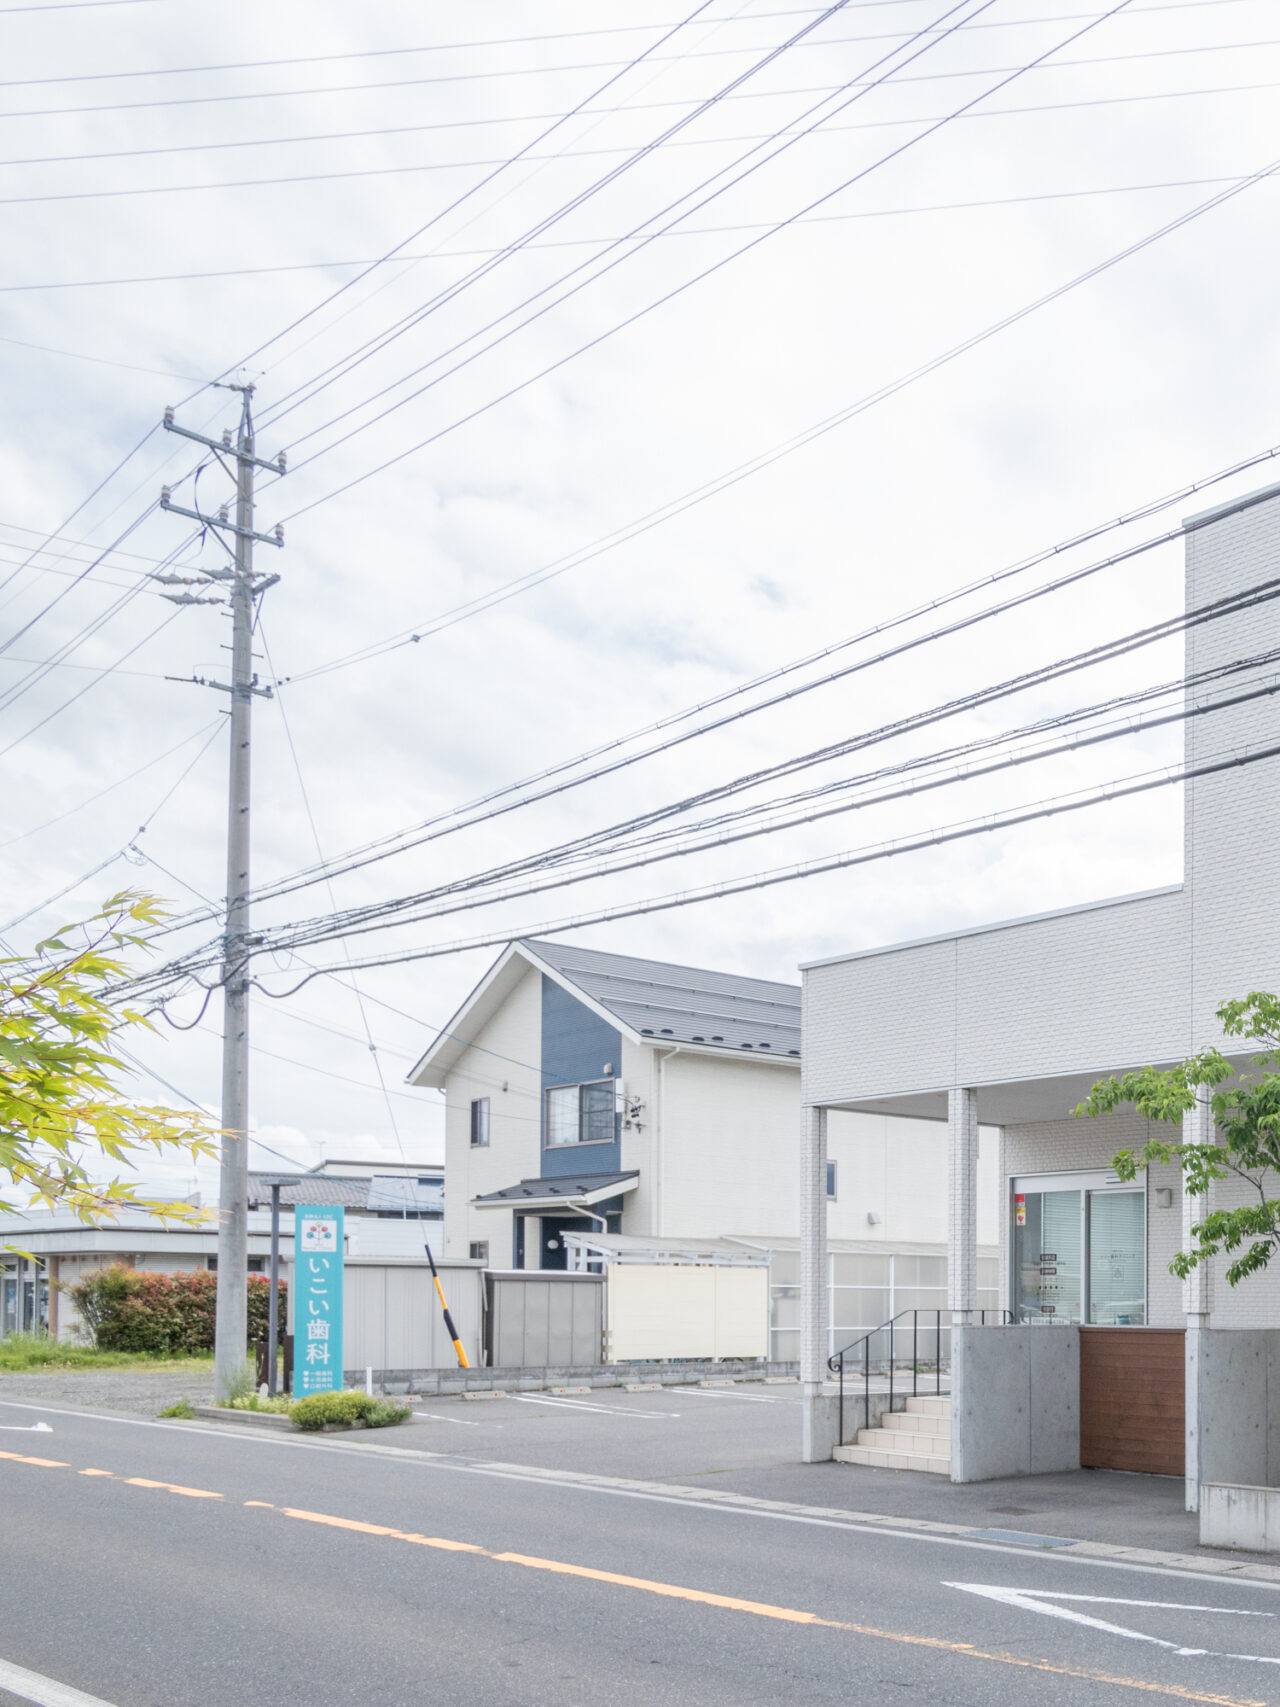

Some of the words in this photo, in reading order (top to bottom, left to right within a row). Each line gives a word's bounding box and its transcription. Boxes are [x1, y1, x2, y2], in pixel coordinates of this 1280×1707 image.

[306, 1258, 331, 1365] いこい歯科
